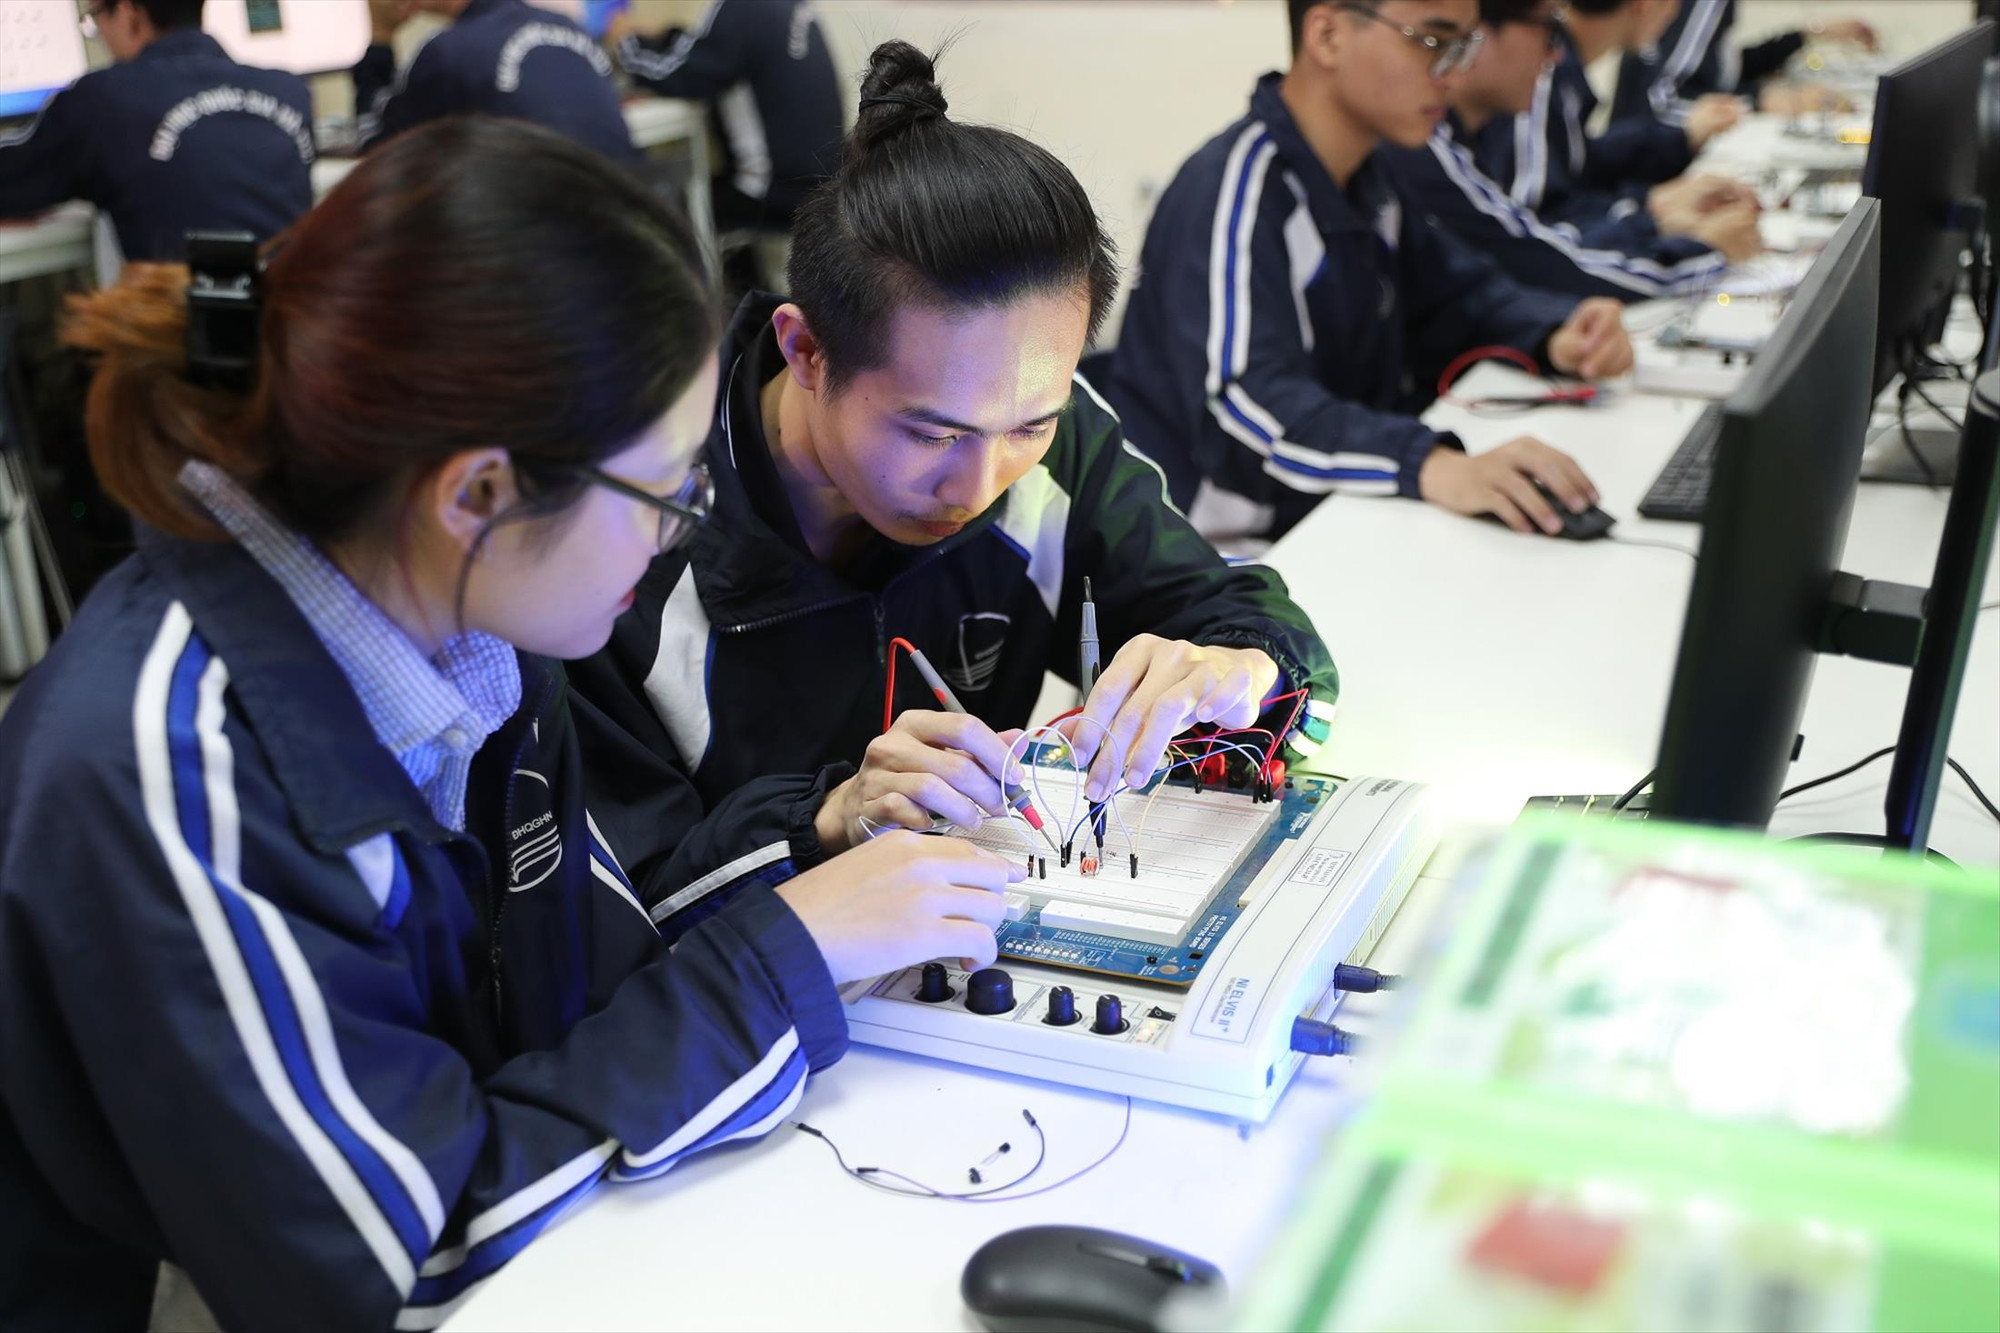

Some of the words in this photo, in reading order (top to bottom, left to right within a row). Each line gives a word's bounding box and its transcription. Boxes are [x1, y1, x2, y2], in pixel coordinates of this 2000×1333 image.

[511, 810, 553, 840] ĐHQGHN
[1236, 978, 1250, 989] NI
[1222, 990, 1244, 1017] ELVIS
